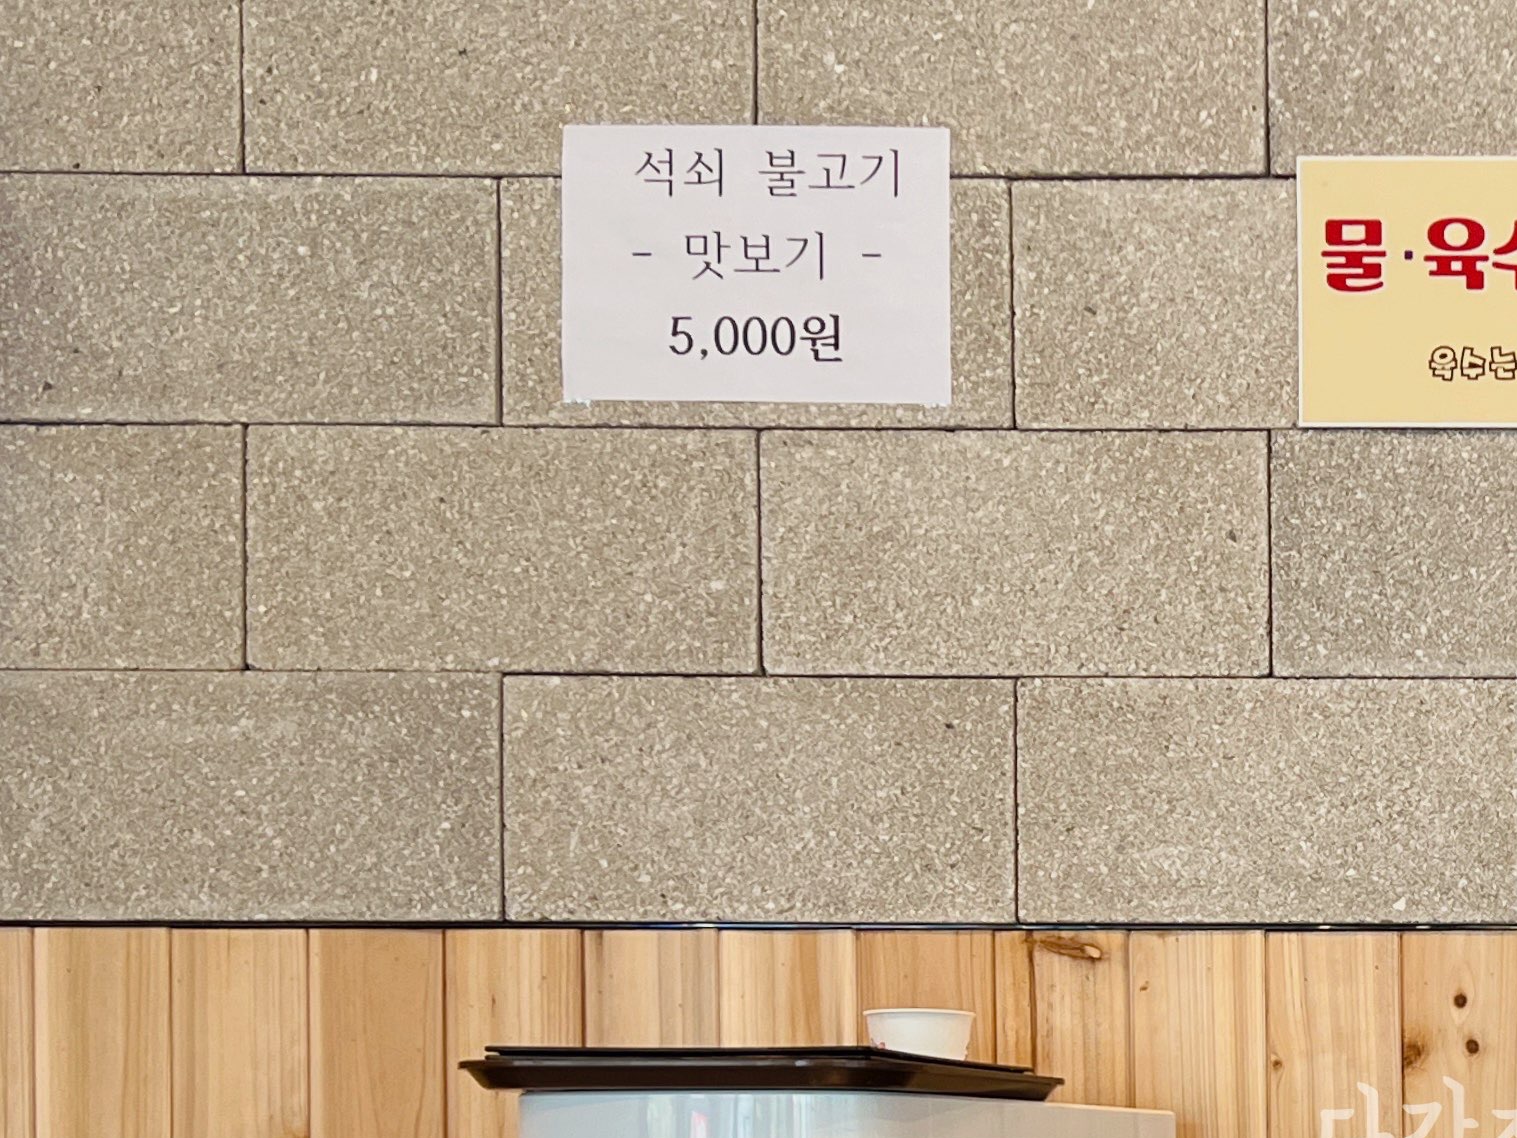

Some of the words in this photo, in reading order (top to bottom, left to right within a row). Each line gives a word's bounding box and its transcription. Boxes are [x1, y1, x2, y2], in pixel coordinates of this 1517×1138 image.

[634, 148, 724, 197] 석쇠
[758, 149, 899, 197] 불고기
[684, 230, 825, 281] 맛보기
[668, 314, 844, 363] 5,000원
[1428, 345, 1517, 381] 육수는
